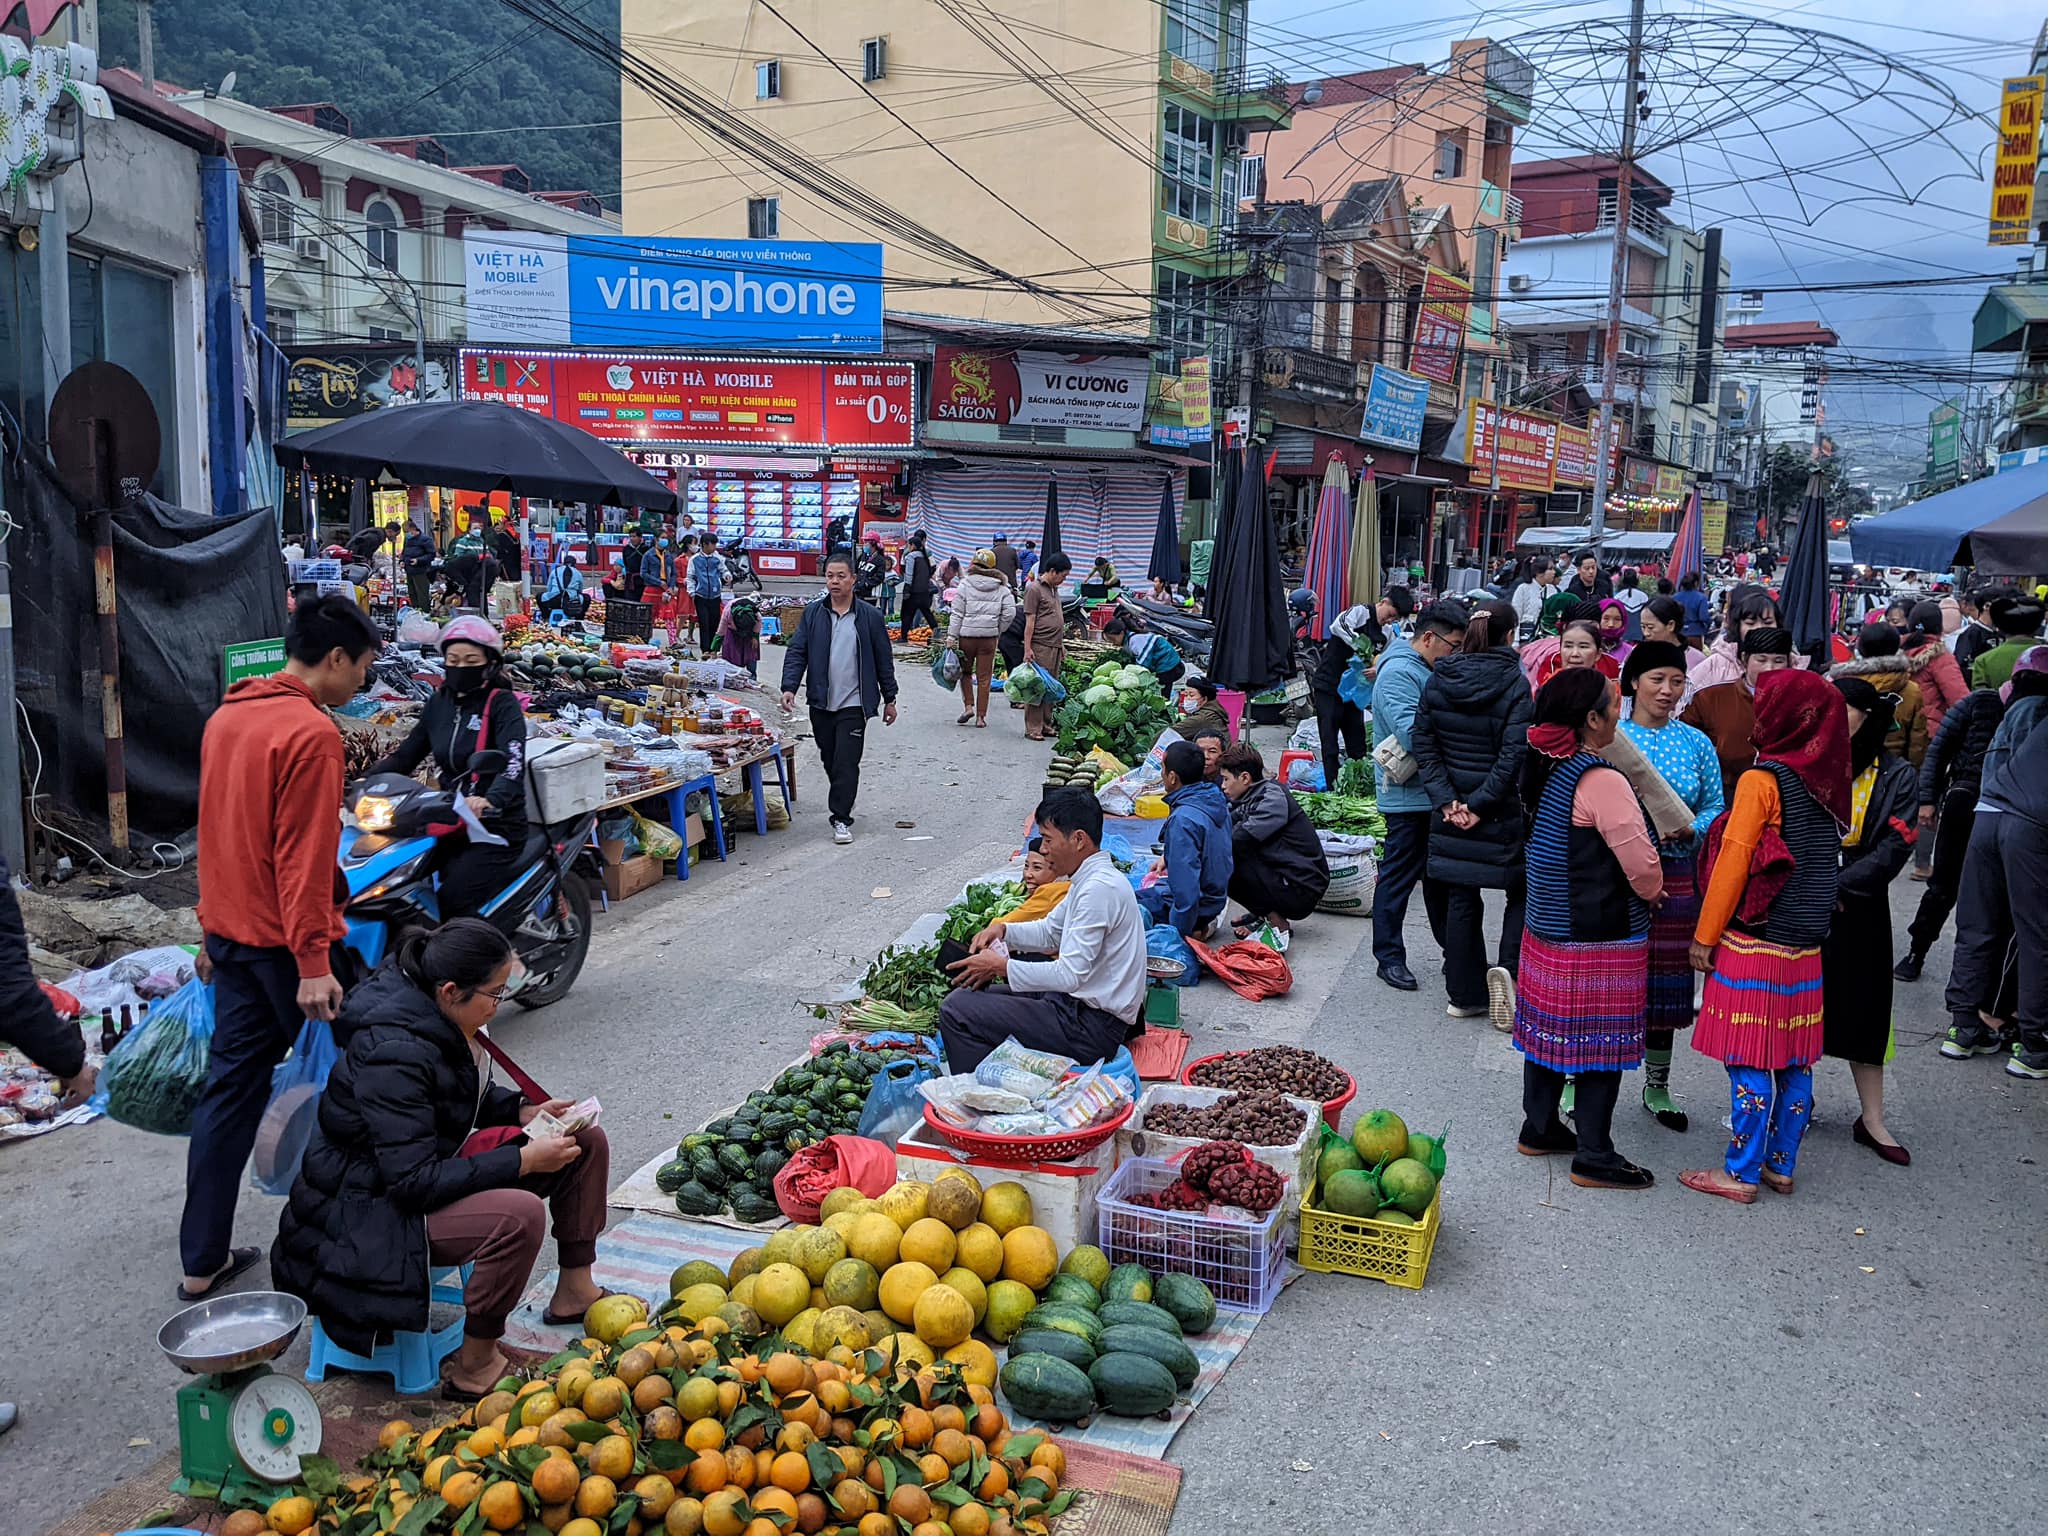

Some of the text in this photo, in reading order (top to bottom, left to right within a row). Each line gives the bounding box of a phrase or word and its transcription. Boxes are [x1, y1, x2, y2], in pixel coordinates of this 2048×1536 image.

[1995, 163, 2035, 189] QUANG
[1997, 193, 2028, 217] MINH
[474, 250, 545, 268] VIỆT HÀ
[716, 250, 739, 260] DỊCH
[741, 252, 754, 261] VỤ
[756, 248, 777, 261] VIỄN
[779, 250, 812, 262] THÔNG
[485, 271, 538, 283] MOBILE
[596, 266, 856, 319] vinaphone
[640, 367, 773, 389] VIỆT HÀ MOBILE
[834, 370, 908, 387] BÁN TRẢ GÓP
[1045, 374, 1129, 394] VI CƯƠNG
[507, 391, 524, 404] ĐIỆN
[526, 393, 549, 406] THOẠI
[578, 390, 599, 404] ĐIỆN
[628, 391, 655, 403] CHÍNH
[700, 395, 718, 407] PHỤ
[720, 393, 741, 407] KIỆN
[743, 394, 770, 406] CHÍNH
[959, 396, 978, 406] BIA
[1028, 395, 1049, 405] BÁCH
[1067, 396, 1089, 407] TỔNG
[1089, 399, 1105, 409] HỢP
[1106, 399, 1122, 409] CÁC
[1122, 401, 1140, 412] LOẠI
[772, 414, 793, 423] iPhone
[938, 404, 997, 420] SAIGON
[643, 453, 666, 466] SIM
[829, 472, 855, 480] SAMSUNG
[232, 652, 246, 667] CÔNG
[246, 649, 267, 665] TRƯỜNG
